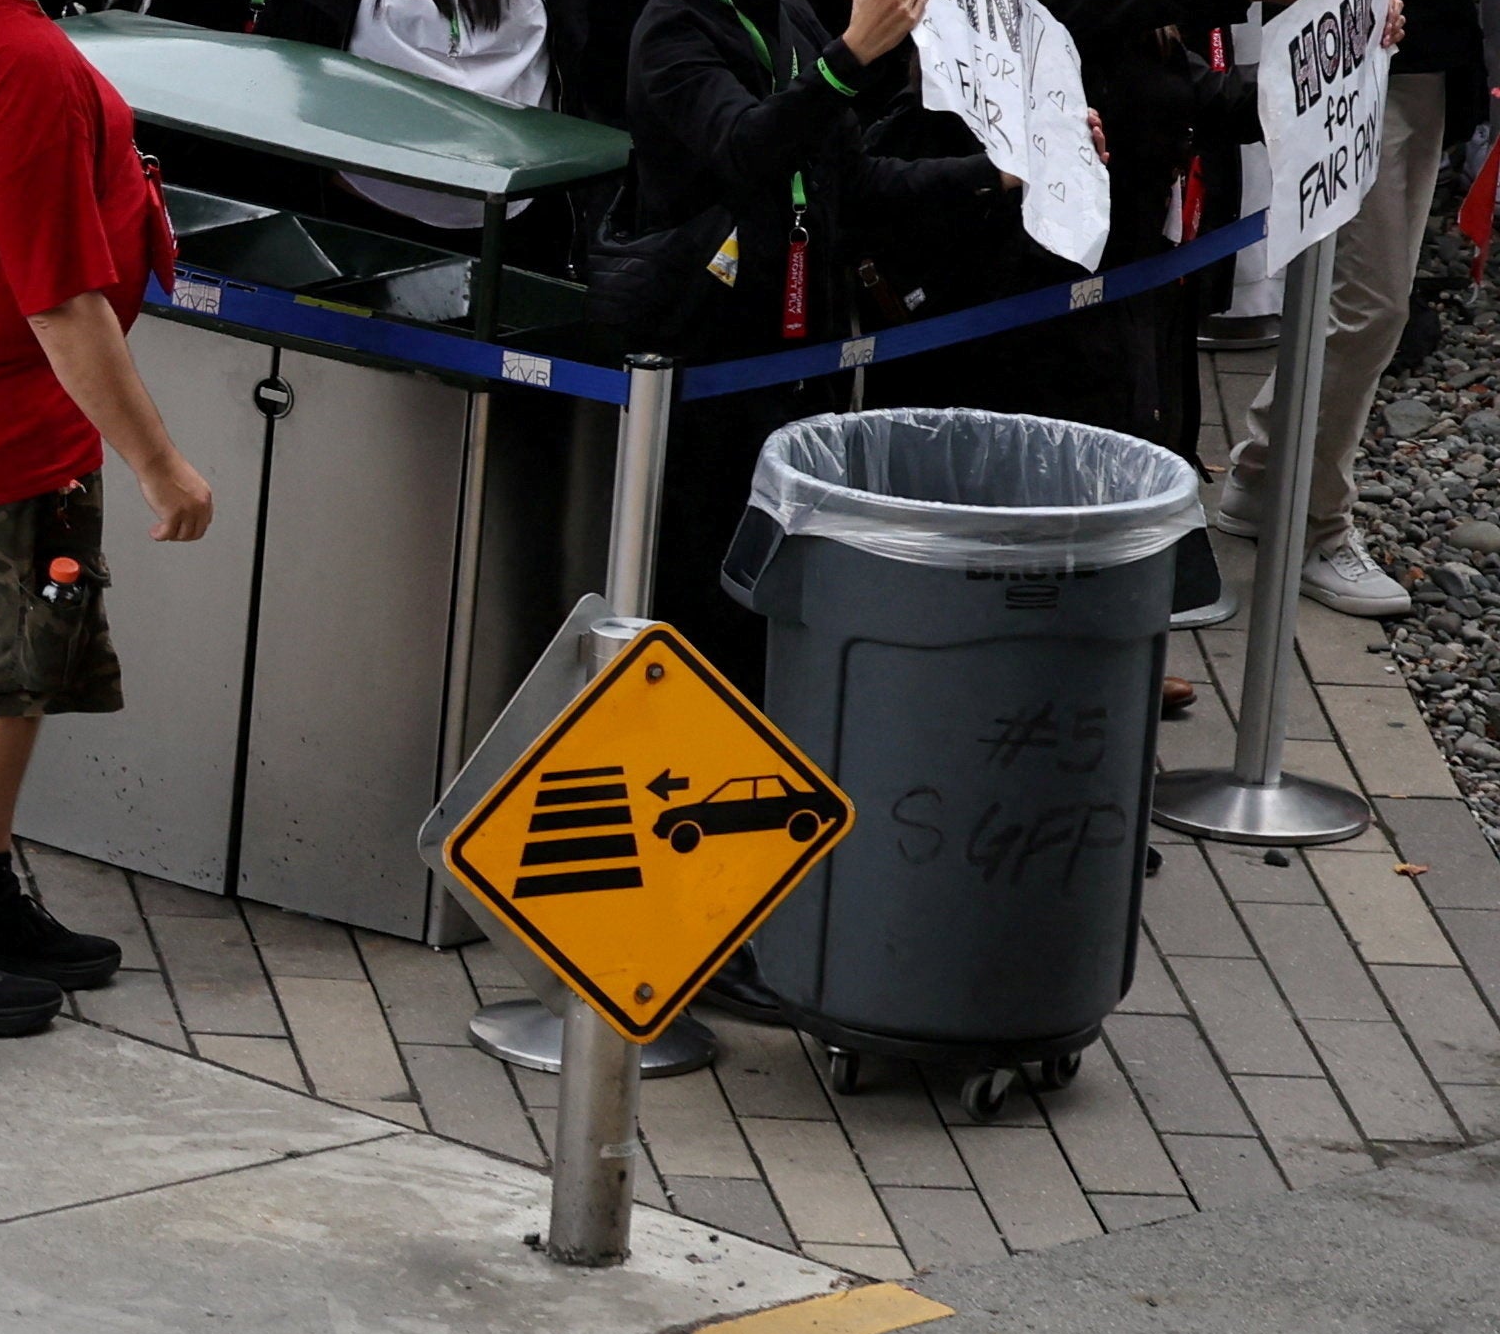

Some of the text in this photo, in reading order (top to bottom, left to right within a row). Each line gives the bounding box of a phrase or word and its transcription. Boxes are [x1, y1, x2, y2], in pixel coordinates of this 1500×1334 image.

[1324, 88, 1360, 144] for
[1300, 145, 1349, 235] FAIR
[173, 289, 220, 315] YVR
[1070, 288, 1104, 310] YVR
[502, 360, 550, 388] YVR
